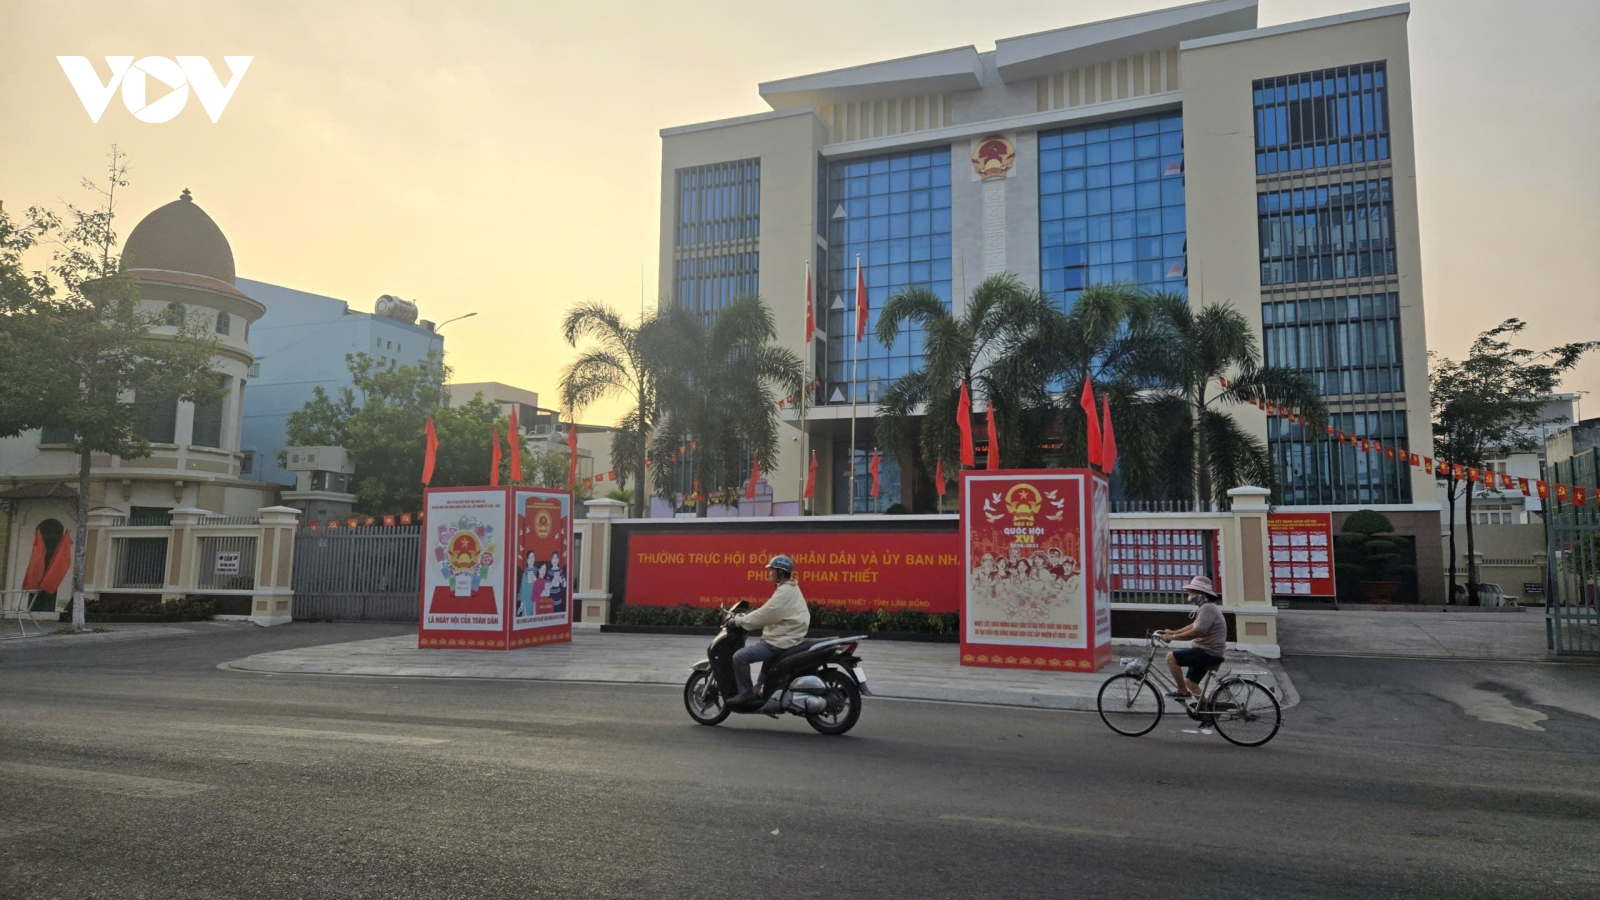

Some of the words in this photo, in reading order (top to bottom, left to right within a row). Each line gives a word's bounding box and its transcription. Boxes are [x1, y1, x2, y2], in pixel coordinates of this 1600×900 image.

[1004, 526, 1027, 535] QUỐC
[1029, 526, 1044, 536] HỘI
[1015, 535, 1034, 543] XVI
[638, 550, 685, 564] THƯỜNG
[688, 551, 720, 567] TRỰC
[724, 550, 745, 567] HỘI
[790, 550, 826, 564] NHÂN
[829, 550, 857, 565] DÂN
[861, 550, 879, 565] VÀ
[882, 549, 901, 565] ỦY
[905, 554, 934, 565] BAN
[937, 554, 960, 565] NH
[803, 571, 838, 582] PHAN
[841, 567, 879, 583] THIẾT
